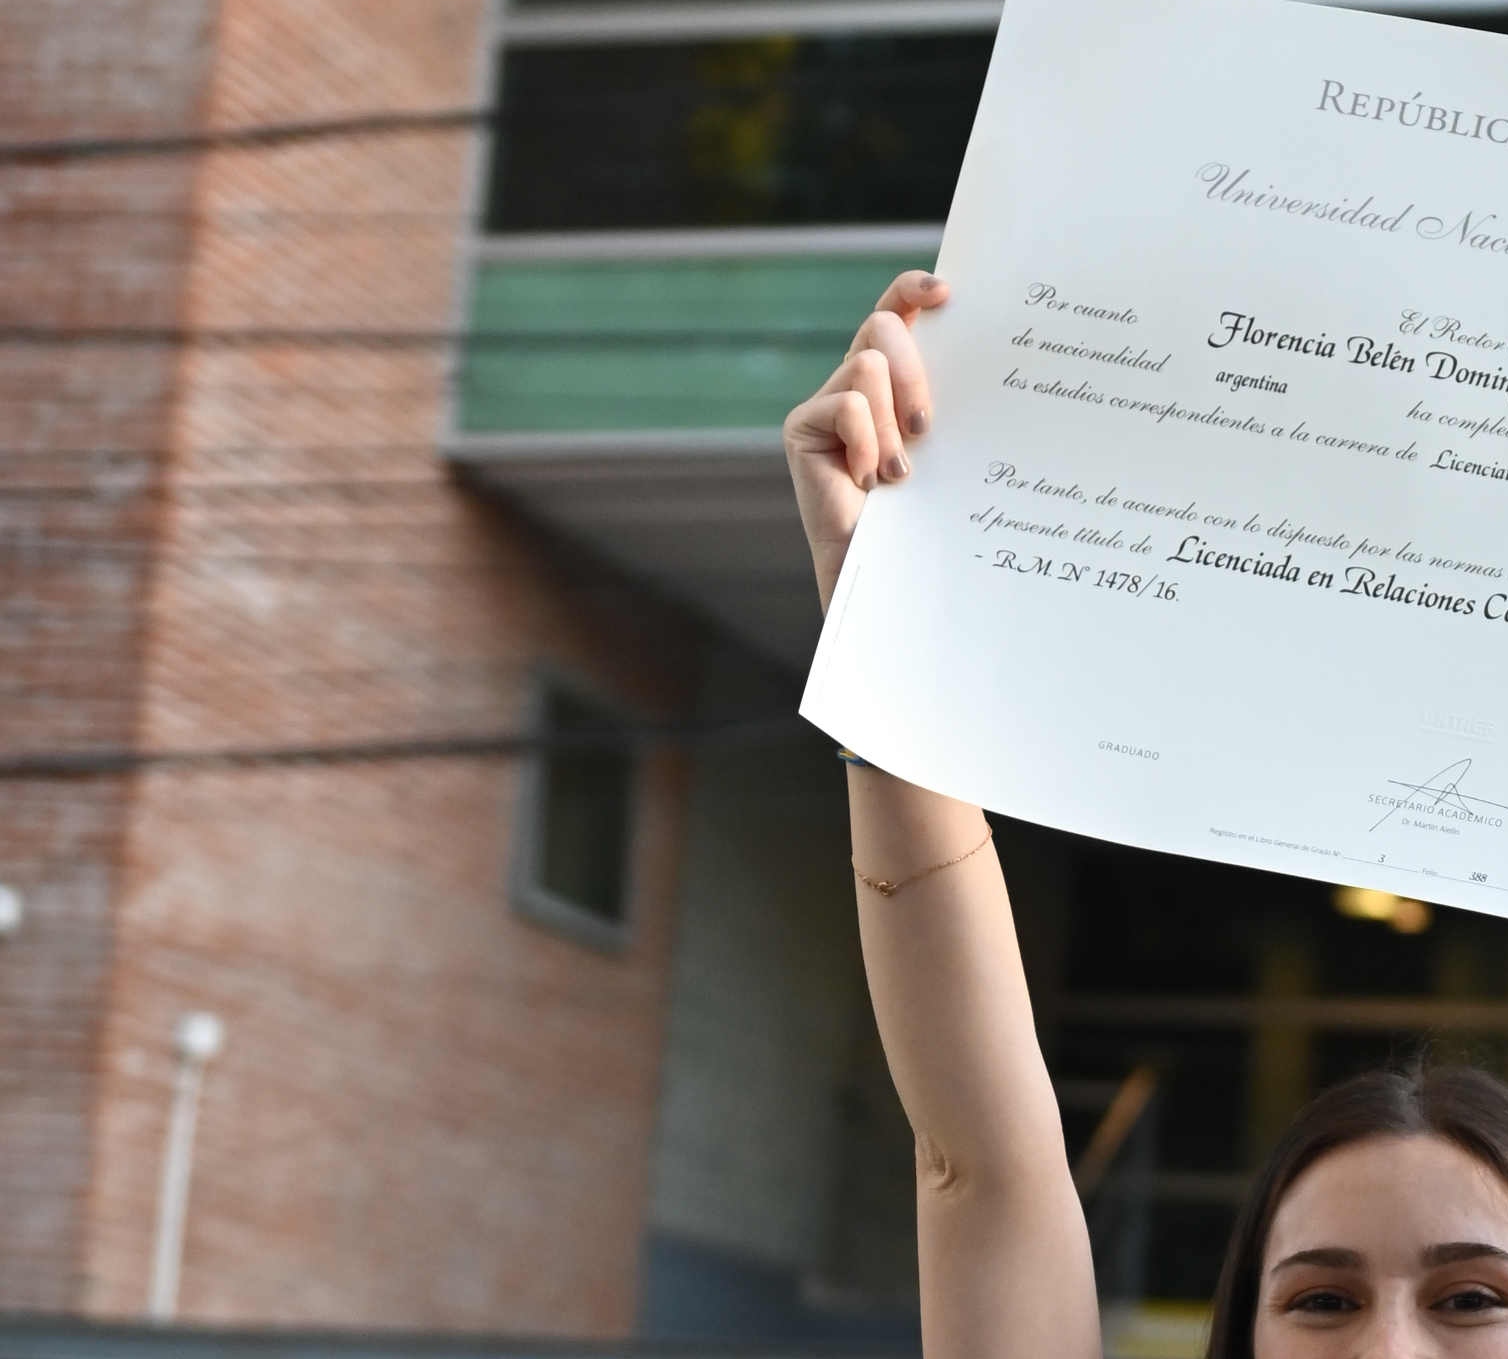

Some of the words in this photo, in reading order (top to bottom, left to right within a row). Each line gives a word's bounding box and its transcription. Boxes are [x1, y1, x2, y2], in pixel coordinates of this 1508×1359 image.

[1194, 163, 1414, 232] Universidad
[1025, 282, 1069, 311] Por
[1073, 305, 1138, 324] cuanto
[1207, 311, 1336, 358] Florencia
[1347, 336, 1415, 373] Belén
[1399, 309, 1429, 335] El
[1429, 316, 1505, 350] Rector
[1012, 327, 1034, 348] de
[1039, 341, 1172, 372] nacionalidad
[1215, 371, 1288, 394] argentina
[1406, 400, 1433, 422] ha
[1003, 368, 1028, 390] los
[1033, 380, 1104, 404] estudios
[1110, 397, 1266, 434] correspondientes
[1271, 427, 1284, 437] a
[1289, 421, 1310, 442] la
[1316, 435, 1390, 456] carrera
[1395, 441, 1418, 461] de
[984, 461, 1029, 489] Por
[1032, 478, 1087, 504] tanto,
[1095, 487, 1118, 506] de
[1123, 500, 1198, 521] acuerdo
[1204, 515, 1237, 529] con
[1243, 513, 1261, 533] lo
[1267, 519, 1350, 550] dispuesto
[1348, 538, 1391, 559] por
[1395, 542, 1423, 563] las
[1429, 557, 1503, 578] normas
[970, 506, 995, 523] el
[983, 512, 1068, 539] presente
[1073, 527, 1123, 549] título
[1130, 535, 1152, 555] de
[1166, 535, 1301, 582] Licenciada
[1307, 571, 1334, 589] en
[1339, 566, 1476, 615] Relaciones
[992, 550, 1053, 577] R.M.
[1093, 570, 1179, 602] 1478/16.
[1099, 741, 1159, 760] GRADUADO
[1368, 794, 1434, 814] SECRETARIO
[1439, 826, 1459, 835] Aiello
[1210, 828, 1237, 838] Registro
[1256, 836, 1272, 844] Libro
[1274, 840, 1300, 849] General
[1311, 847, 1331, 855] Grado
[1378, 854, 1385, 863] 3
[1422, 868, 1438, 876] Folio
[1469, 872, 1488, 882] 388
